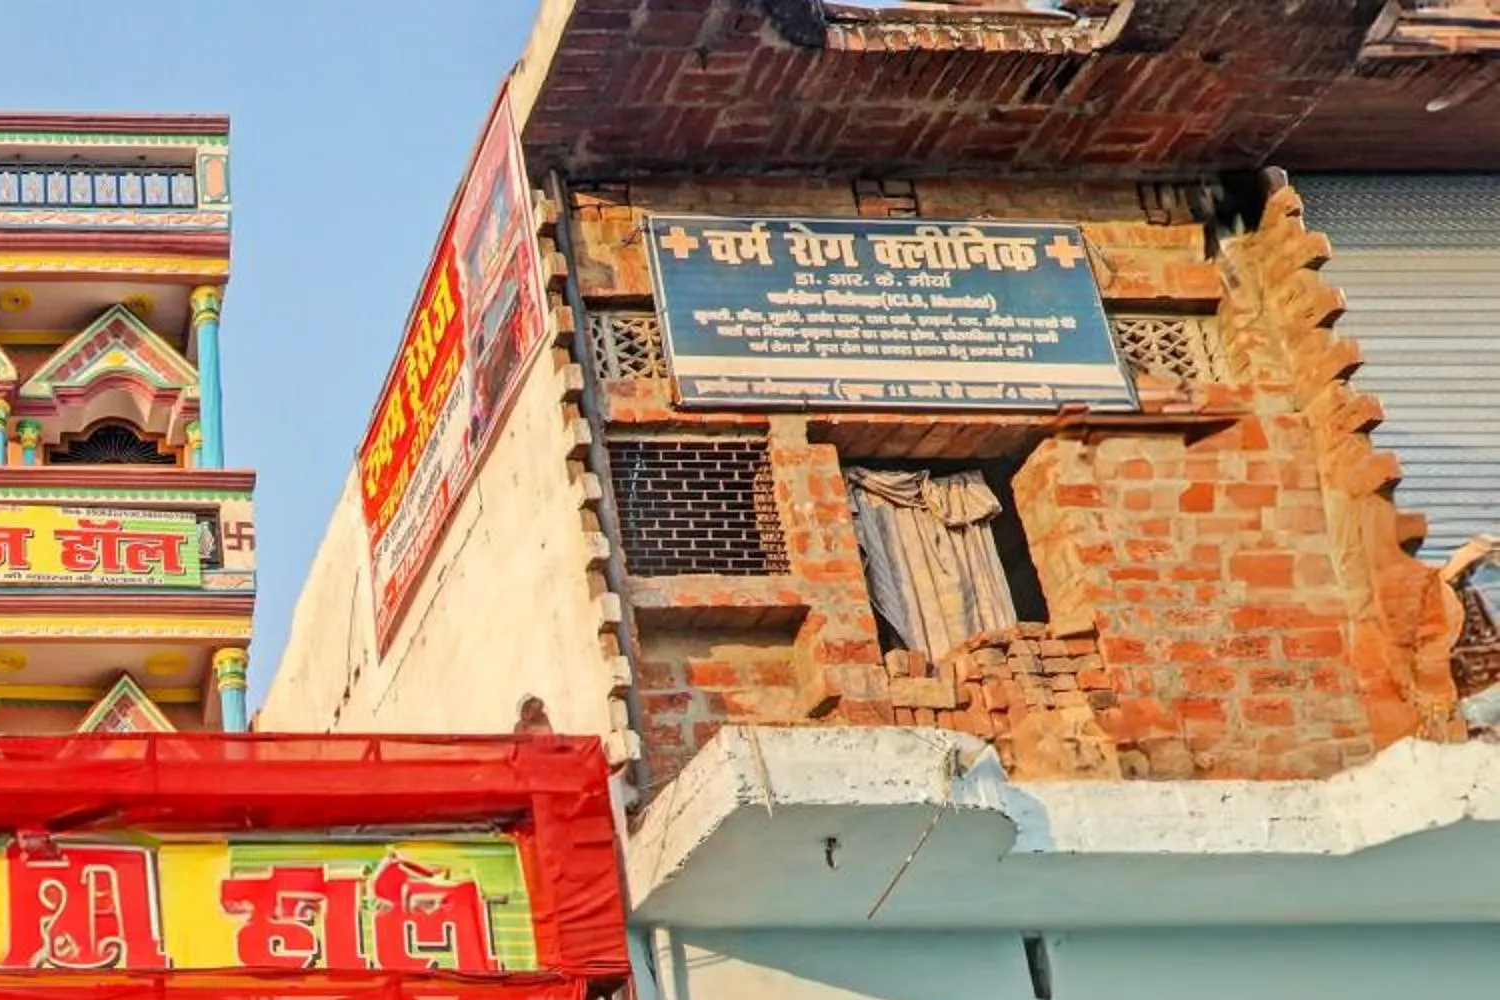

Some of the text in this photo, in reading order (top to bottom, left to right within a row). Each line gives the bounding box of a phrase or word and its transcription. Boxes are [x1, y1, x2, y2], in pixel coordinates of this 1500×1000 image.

[702, 222, 1038, 272] चर्म रोग क्लीनिक
[54, 519, 188, 575] हॉल
